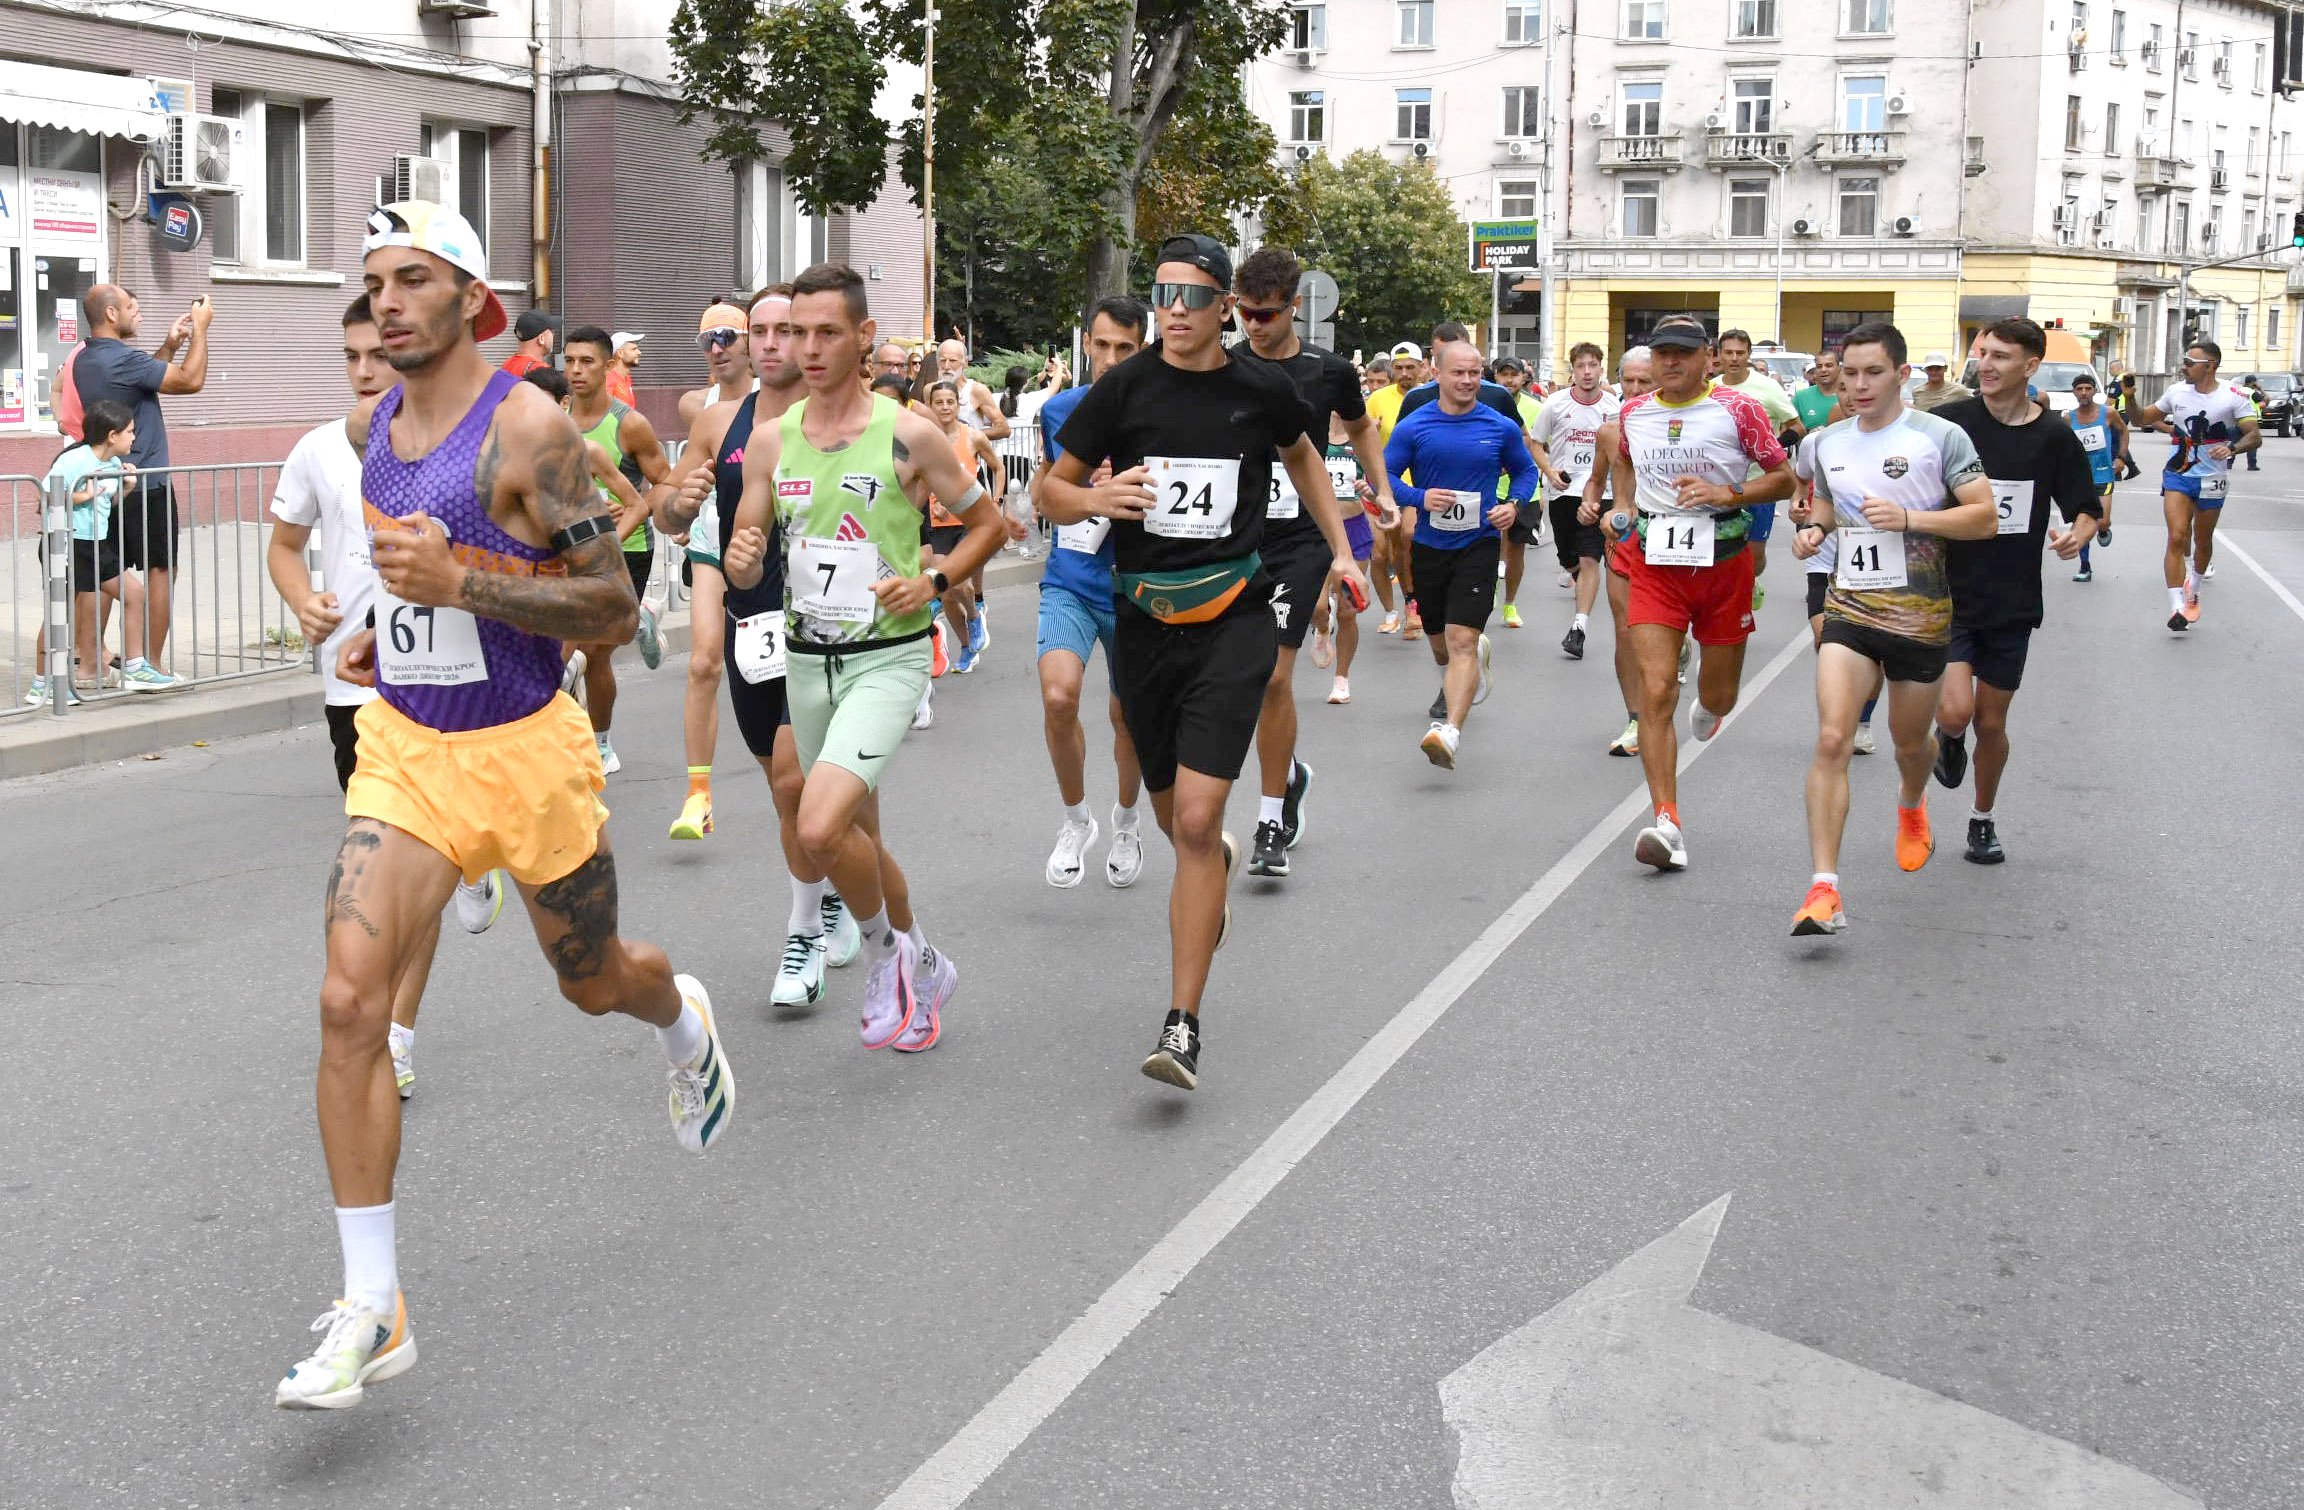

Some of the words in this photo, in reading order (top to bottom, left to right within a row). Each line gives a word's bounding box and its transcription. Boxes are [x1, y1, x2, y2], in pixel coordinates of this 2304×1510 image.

[169, 212, 187, 225] Easy
[168, 221, 182, 233] Pay
[1477, 224, 1534, 237] Praktiker
[1485, 246, 1530, 256] HOLIDAY
[1485, 255, 1513, 265] PARK
[2083, 434, 2097, 445] 62
[1574, 451, 1592, 465] 66
[1641, 447, 1649, 459] A
[780, 483, 809, 492] SLS
[1168, 480, 1213, 516] 24
[1441, 503, 1466, 521] 20
[1664, 526, 1695, 550] 14
[1850, 544, 1884, 572] 41
[816, 563, 837, 597] 7
[390, 605, 435, 654] 67
[454, 661, 478, 671] КРОС
